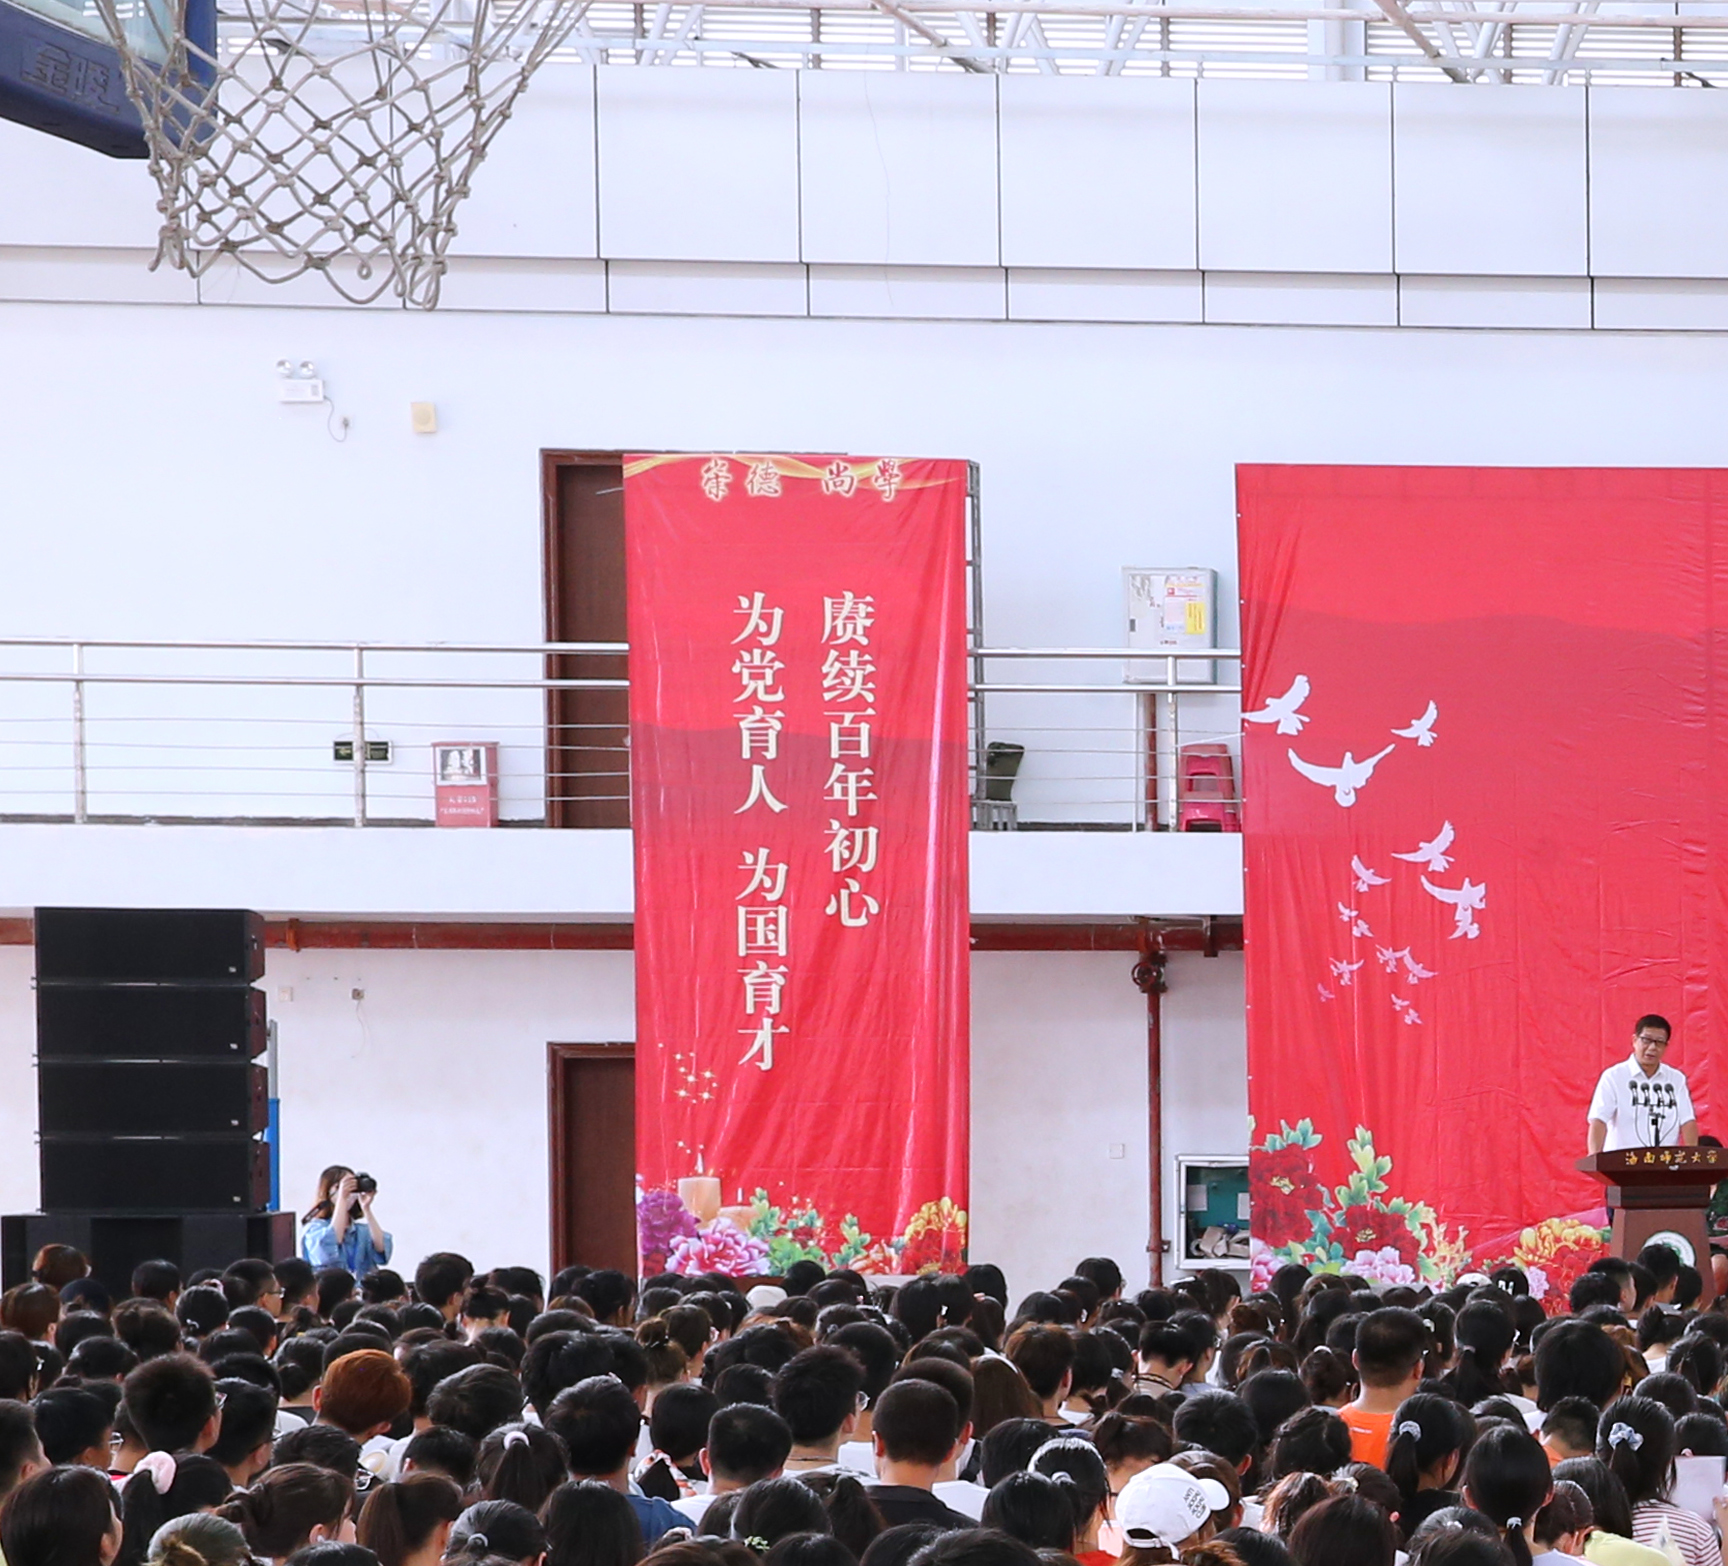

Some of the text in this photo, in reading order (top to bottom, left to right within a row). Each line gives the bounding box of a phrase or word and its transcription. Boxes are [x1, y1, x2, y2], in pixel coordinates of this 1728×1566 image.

[731, 591, 790, 1072] 为党育人 为国育才
[821, 590, 880, 928] 赓续百年初心
